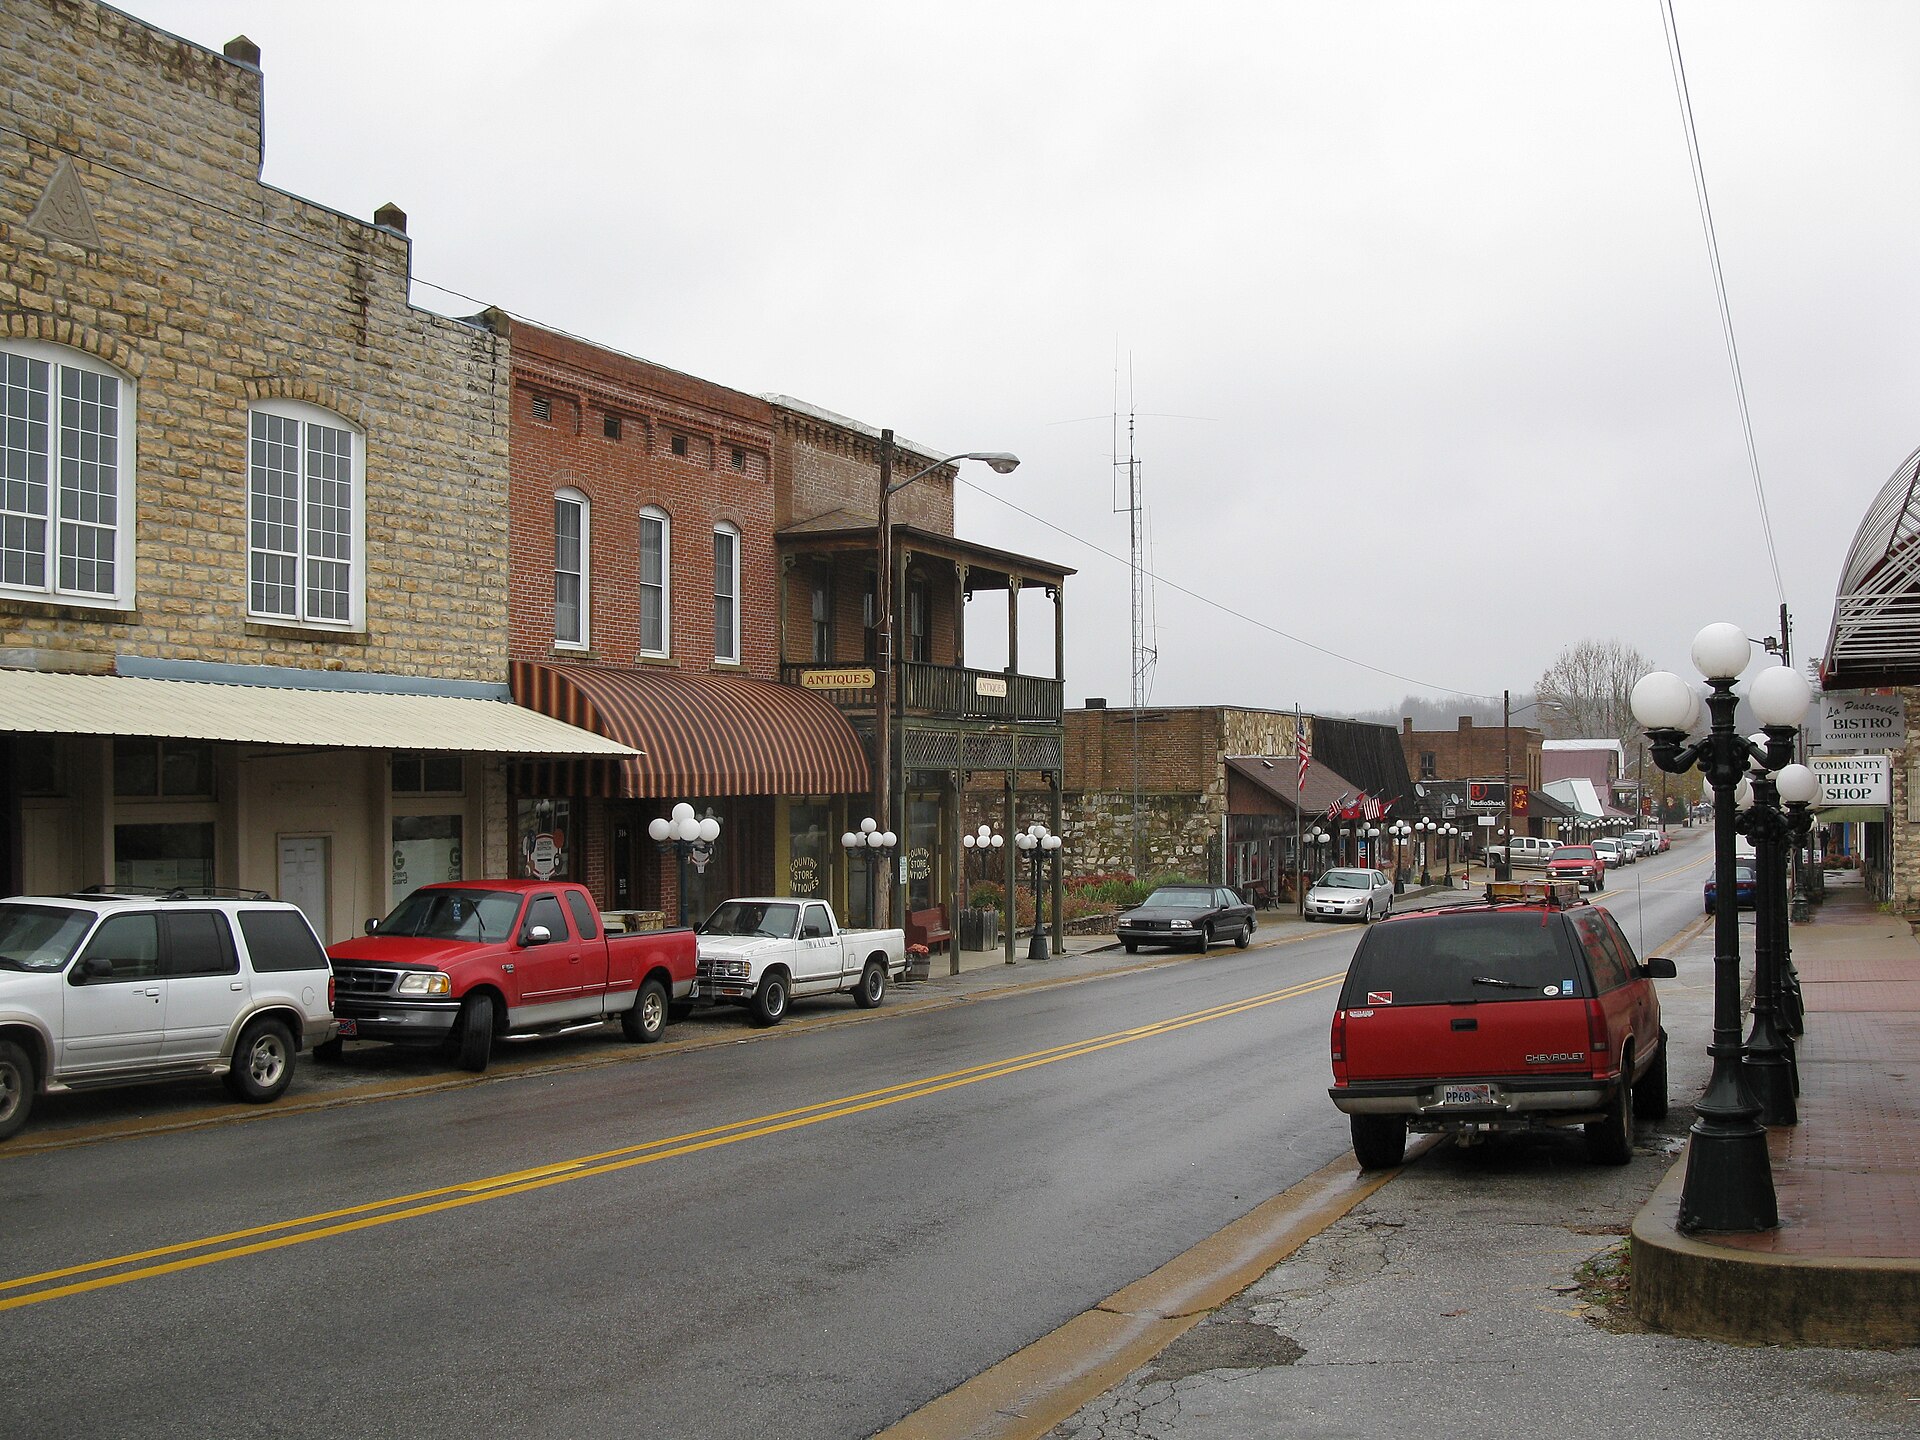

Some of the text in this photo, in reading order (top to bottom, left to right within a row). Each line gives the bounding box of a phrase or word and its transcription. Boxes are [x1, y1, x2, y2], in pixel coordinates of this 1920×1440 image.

[806, 674, 871, 685] ANTIQUES
[977, 683, 1006, 694] ANTIQUES
[1826, 701, 1900, 719] La Pastorella
[1833, 717, 1892, 730] BISTRO
[1825, 731, 1901, 740] COMFORT FOODS
[1813, 761, 1882, 770] COMMUNITY
[1814, 773, 1883, 785] THRIFT
[1825, 788, 1872, 800] SHOP
[1470, 799, 1506, 807] RadioShack
[789, 856, 818, 872] COUNTRY
[910, 859, 927, 869] STORE
[793, 870, 814, 880] STORE
[789, 876, 820, 893] ANTIQUES
[1525, 1052, 1585, 1062] CHEVROLET
[1446, 1091, 1471, 1103] PP68
